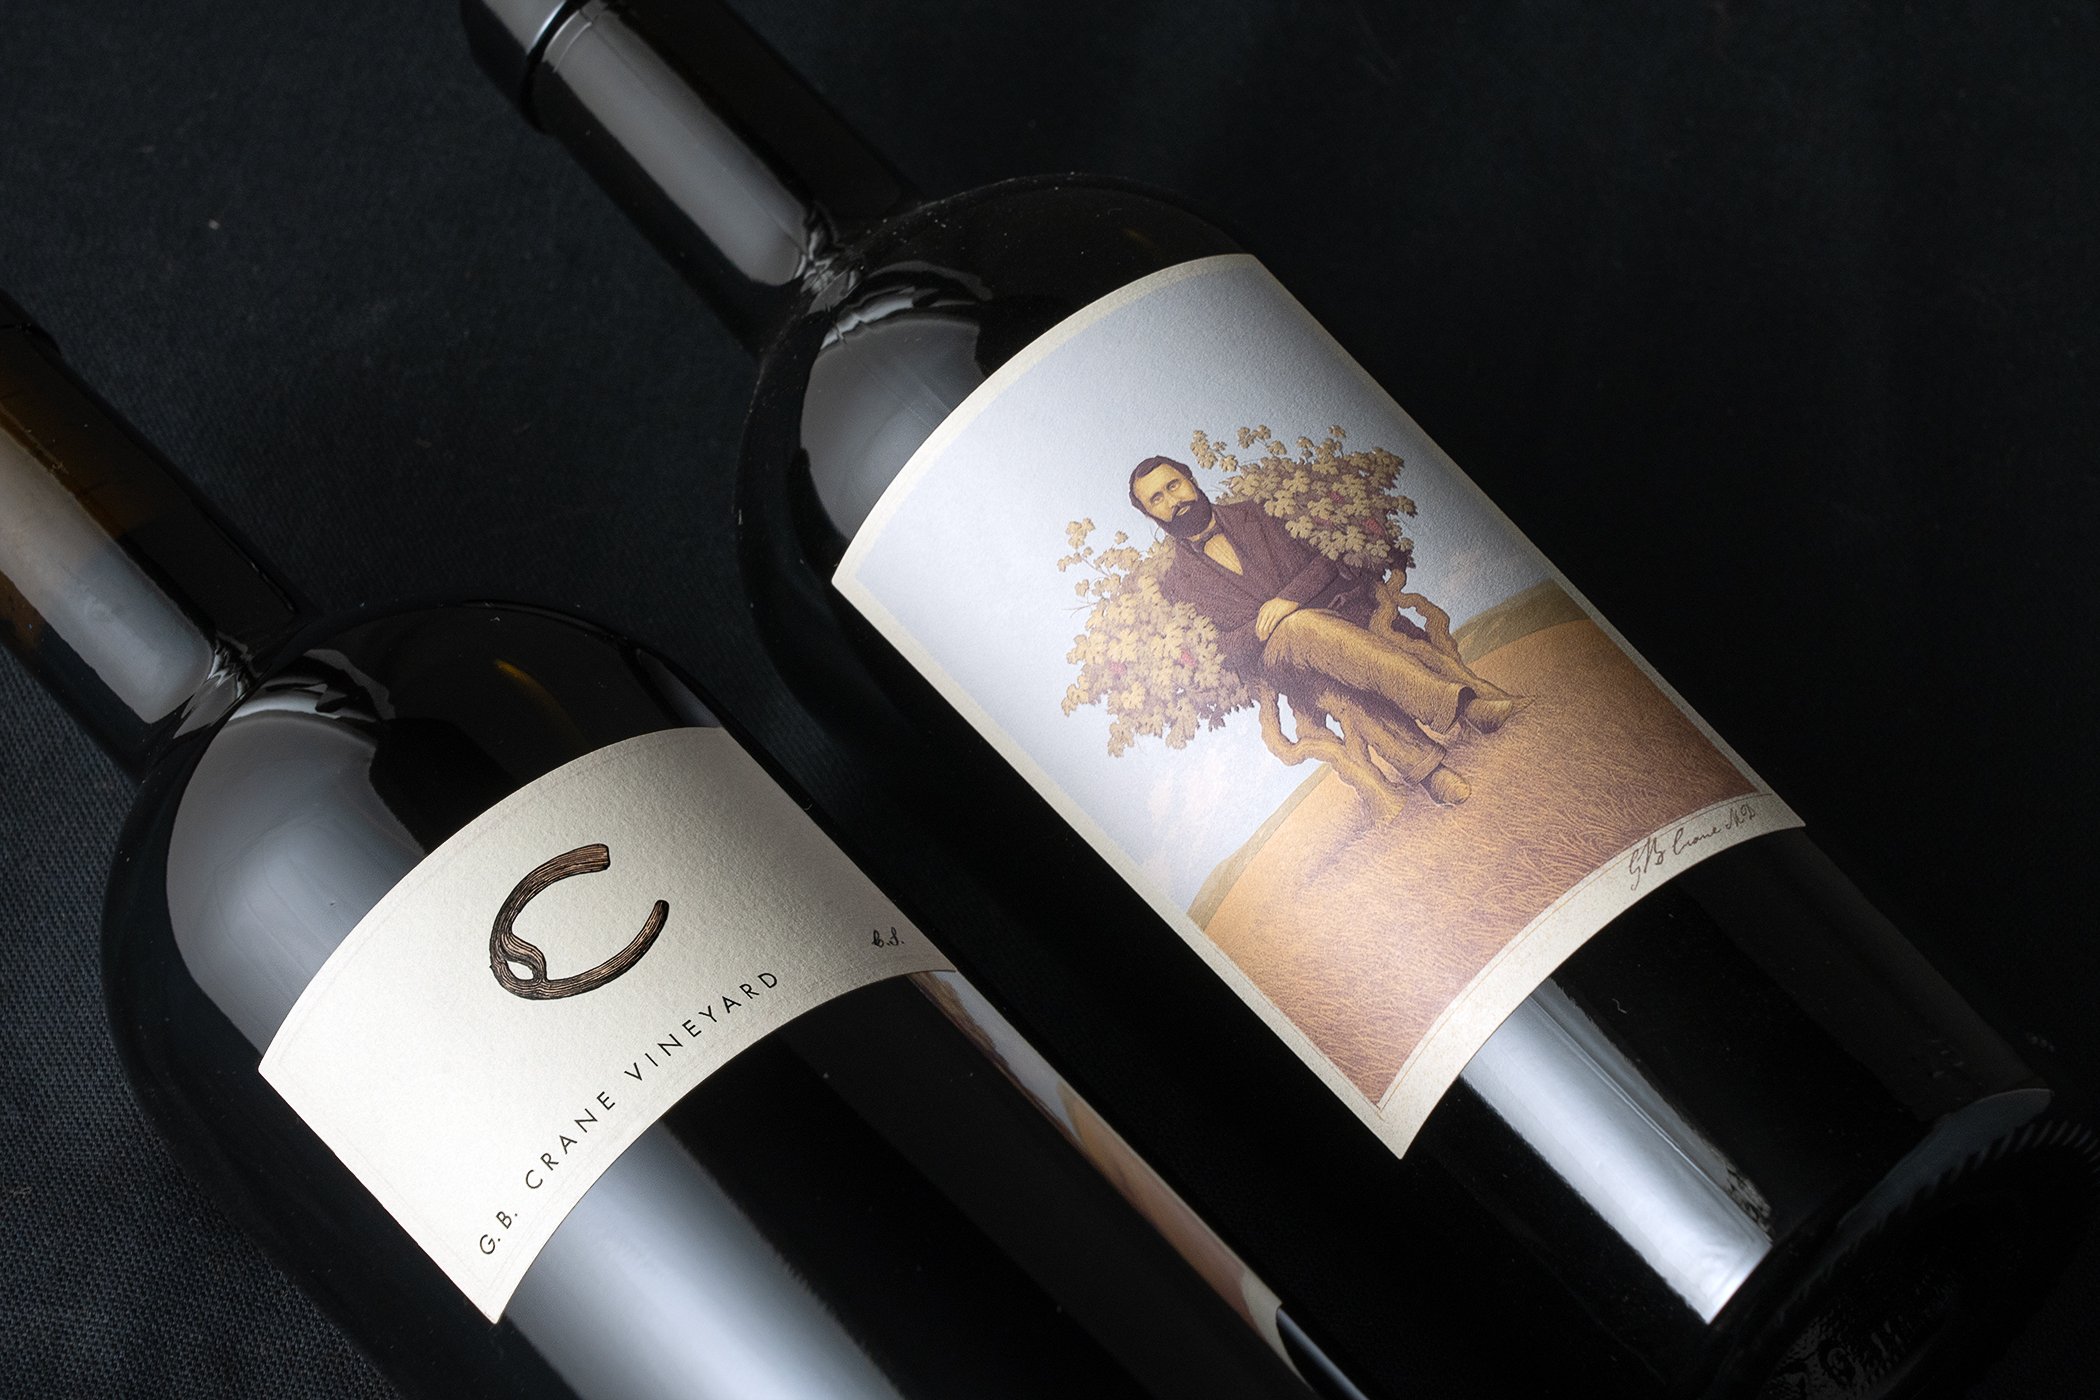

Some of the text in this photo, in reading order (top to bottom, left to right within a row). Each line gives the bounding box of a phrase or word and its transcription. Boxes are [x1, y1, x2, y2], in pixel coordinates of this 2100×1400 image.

[1672, 827, 1721, 856] Crane
[525, 1091, 616, 1190] CRANE
[624, 972, 778, 1081] VINEYARD
